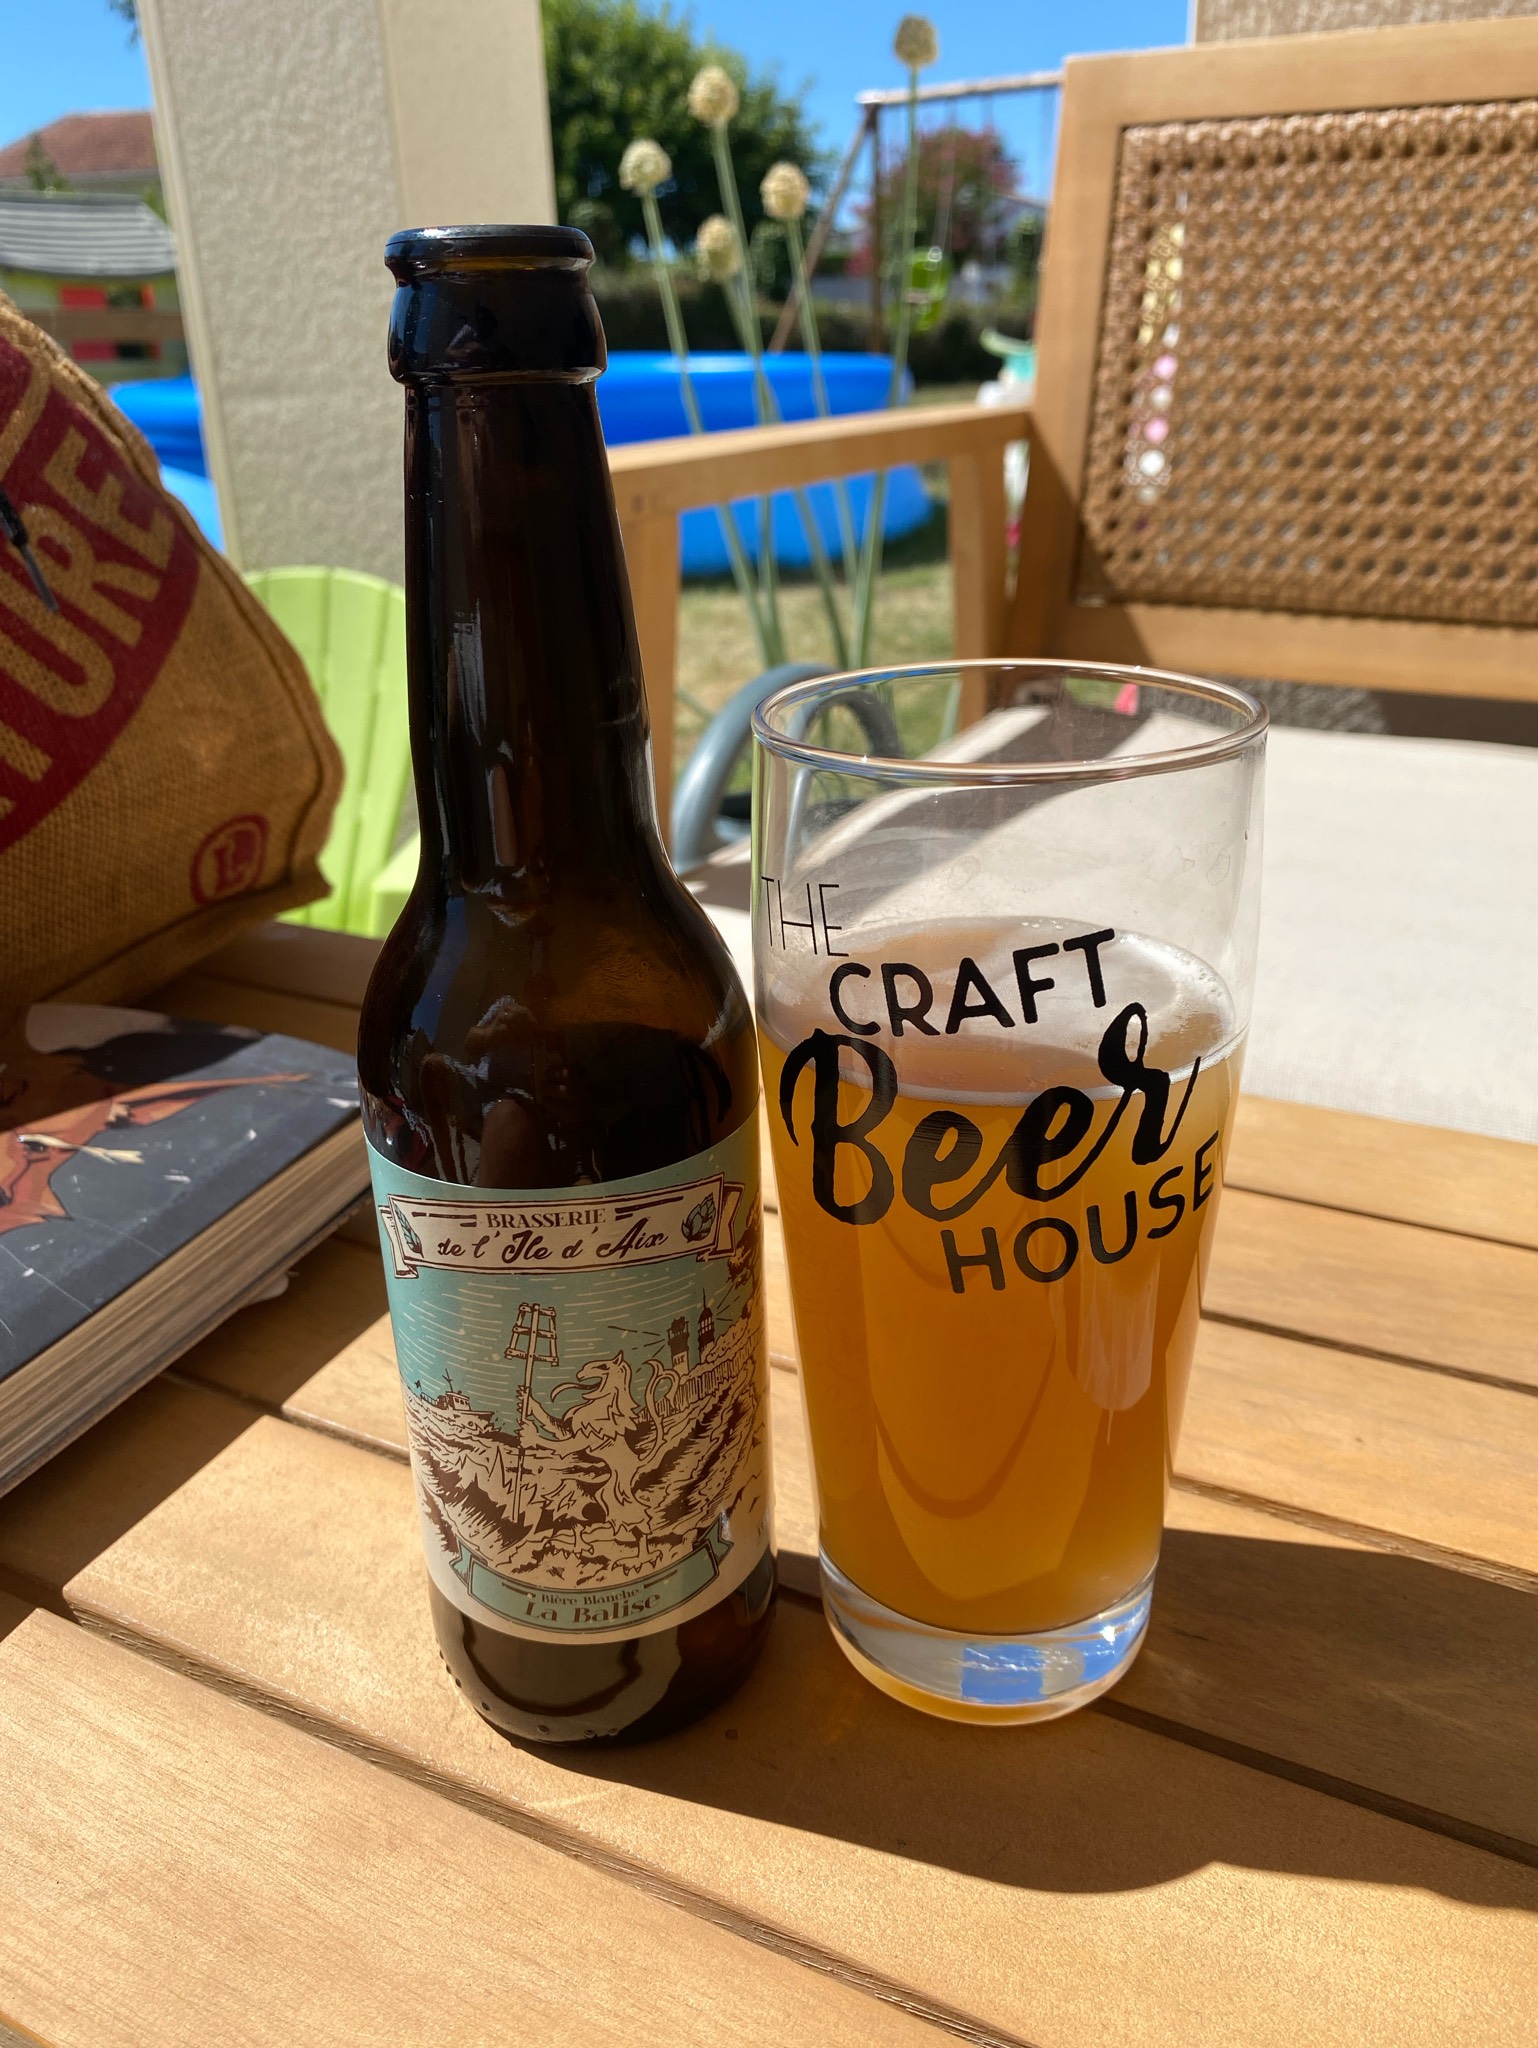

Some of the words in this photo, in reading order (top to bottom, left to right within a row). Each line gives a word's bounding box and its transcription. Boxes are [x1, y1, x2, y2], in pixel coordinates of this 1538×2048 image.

[761, 876, 849, 957] THE
[829, 928, 1115, 1036] CRAFT
[779, 1002, 1201, 1225] Beer
[485, 1208, 606, 1228] BRASSERIE
[939, 1130, 1219, 1294] HOUSE
[437, 1237, 466, 1256] de
[525, 1601, 558, 1622] La
[573, 1594, 660, 1623] Balise
[541, 1594, 578, 1605] Bière
[583, 1589, 639, 1605] Blanche
